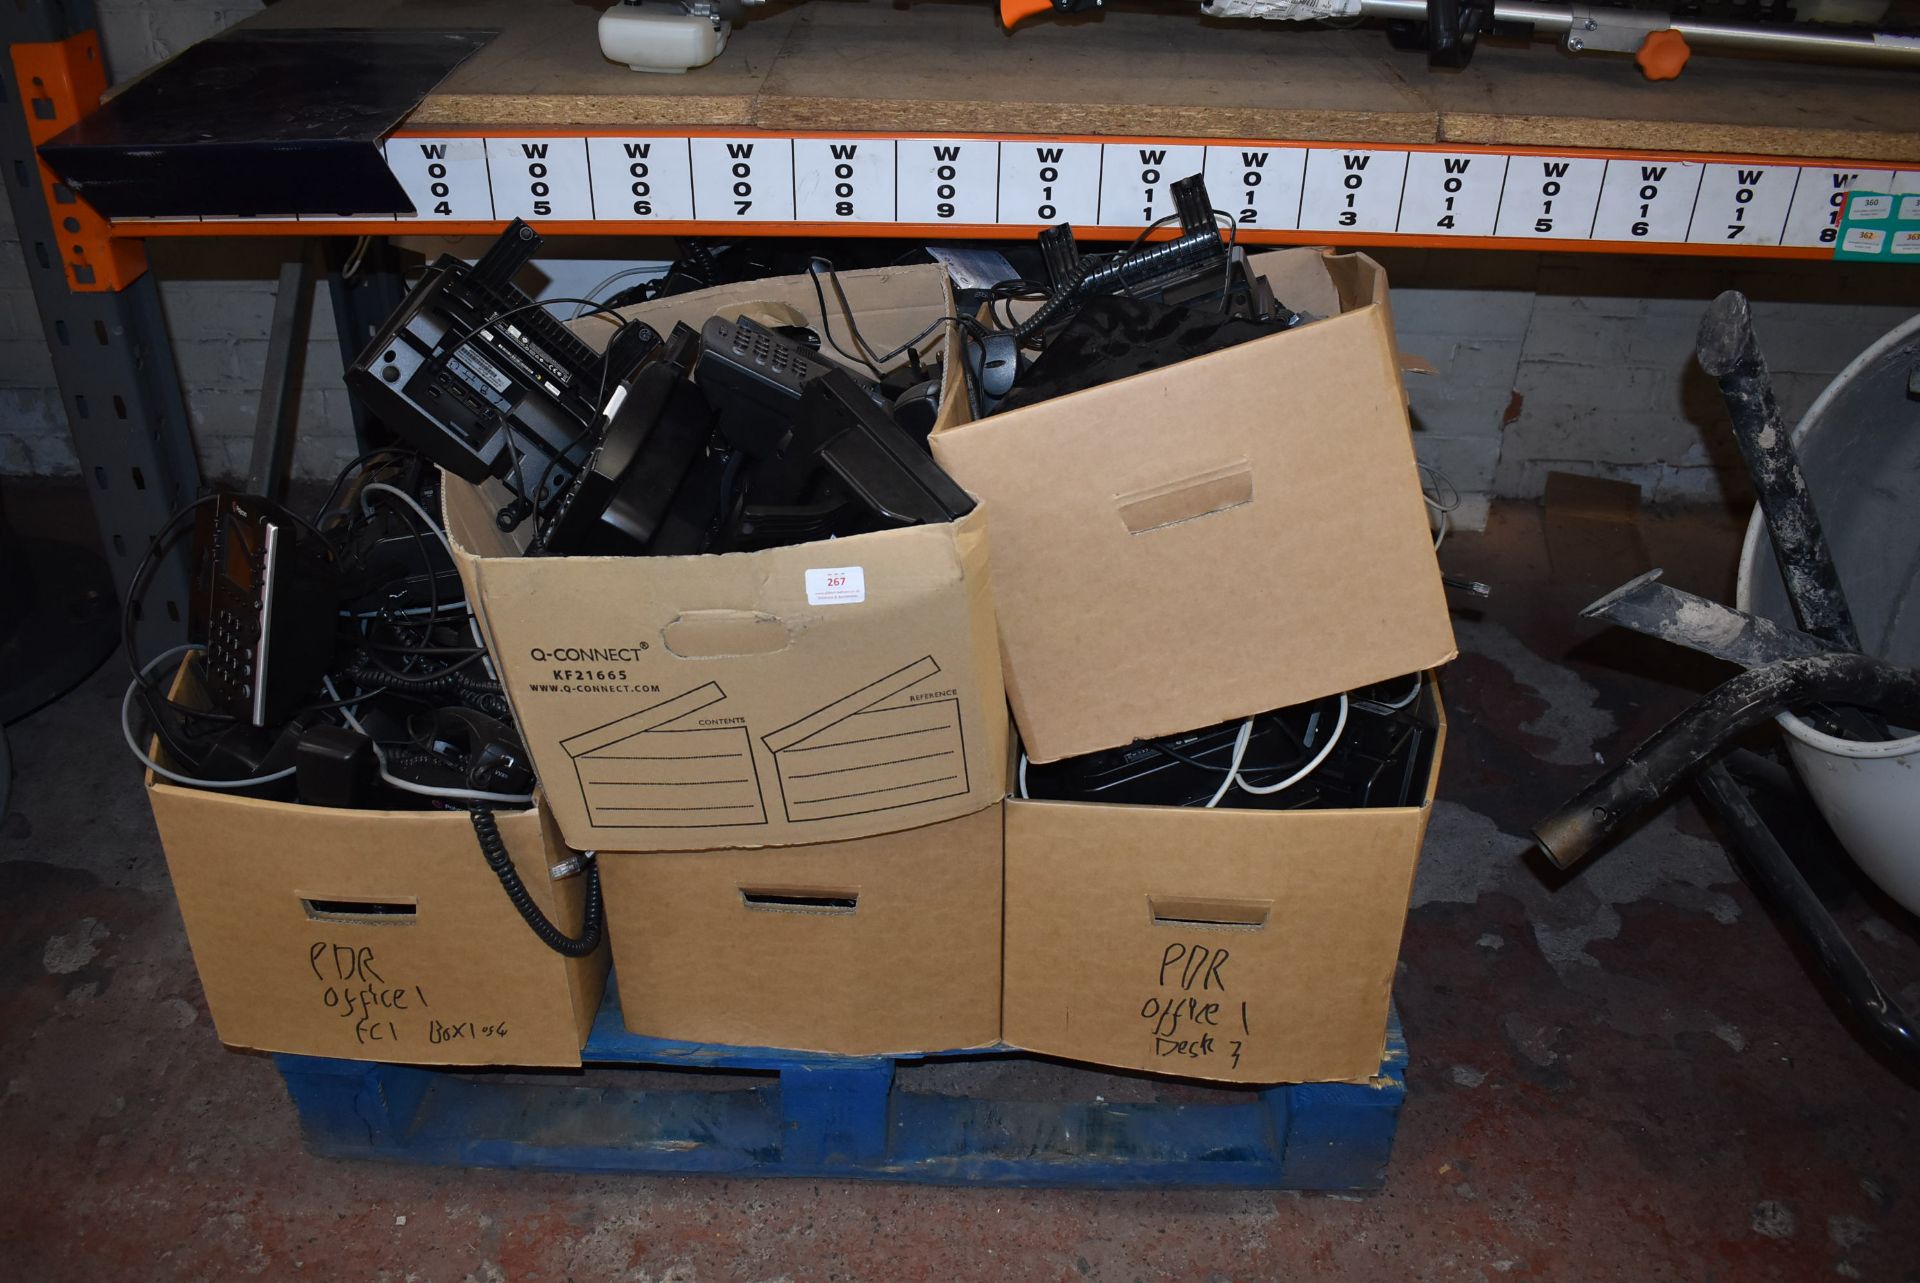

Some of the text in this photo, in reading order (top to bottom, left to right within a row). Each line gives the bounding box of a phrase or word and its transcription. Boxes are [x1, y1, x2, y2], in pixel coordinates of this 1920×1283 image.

[420, 144, 452, 216] W004
[521, 144, 552, 216] W005
[623, 144, 652, 216] W006
[726, 144, 754, 216] W007
[829, 144, 857, 216] W008
[933, 146, 961, 218] W009
[1036, 148, 1064, 220] W010
[1139, 150, 1166, 222] W011
[1238, 152, 1268, 224] W012
[1338, 155, 1370, 226] W013
[1437, 158, 1470, 230] W014
[1534, 162, 1569, 233] W015
[1631, 166, 1667, 237] W016
[1727, 169, 1763, 240] W017
[827, 577, 846, 587] 267
[529, 684, 660, 693] WWW.Q-CONNECT.COM
[553, 670, 627, 681] KF21665
[909, 689, 957, 702] REFERENCE
[698, 717, 745, 726] CONTENTS
[310, 942, 385, 983] PDR
[1159, 943, 1230, 991] PDR
